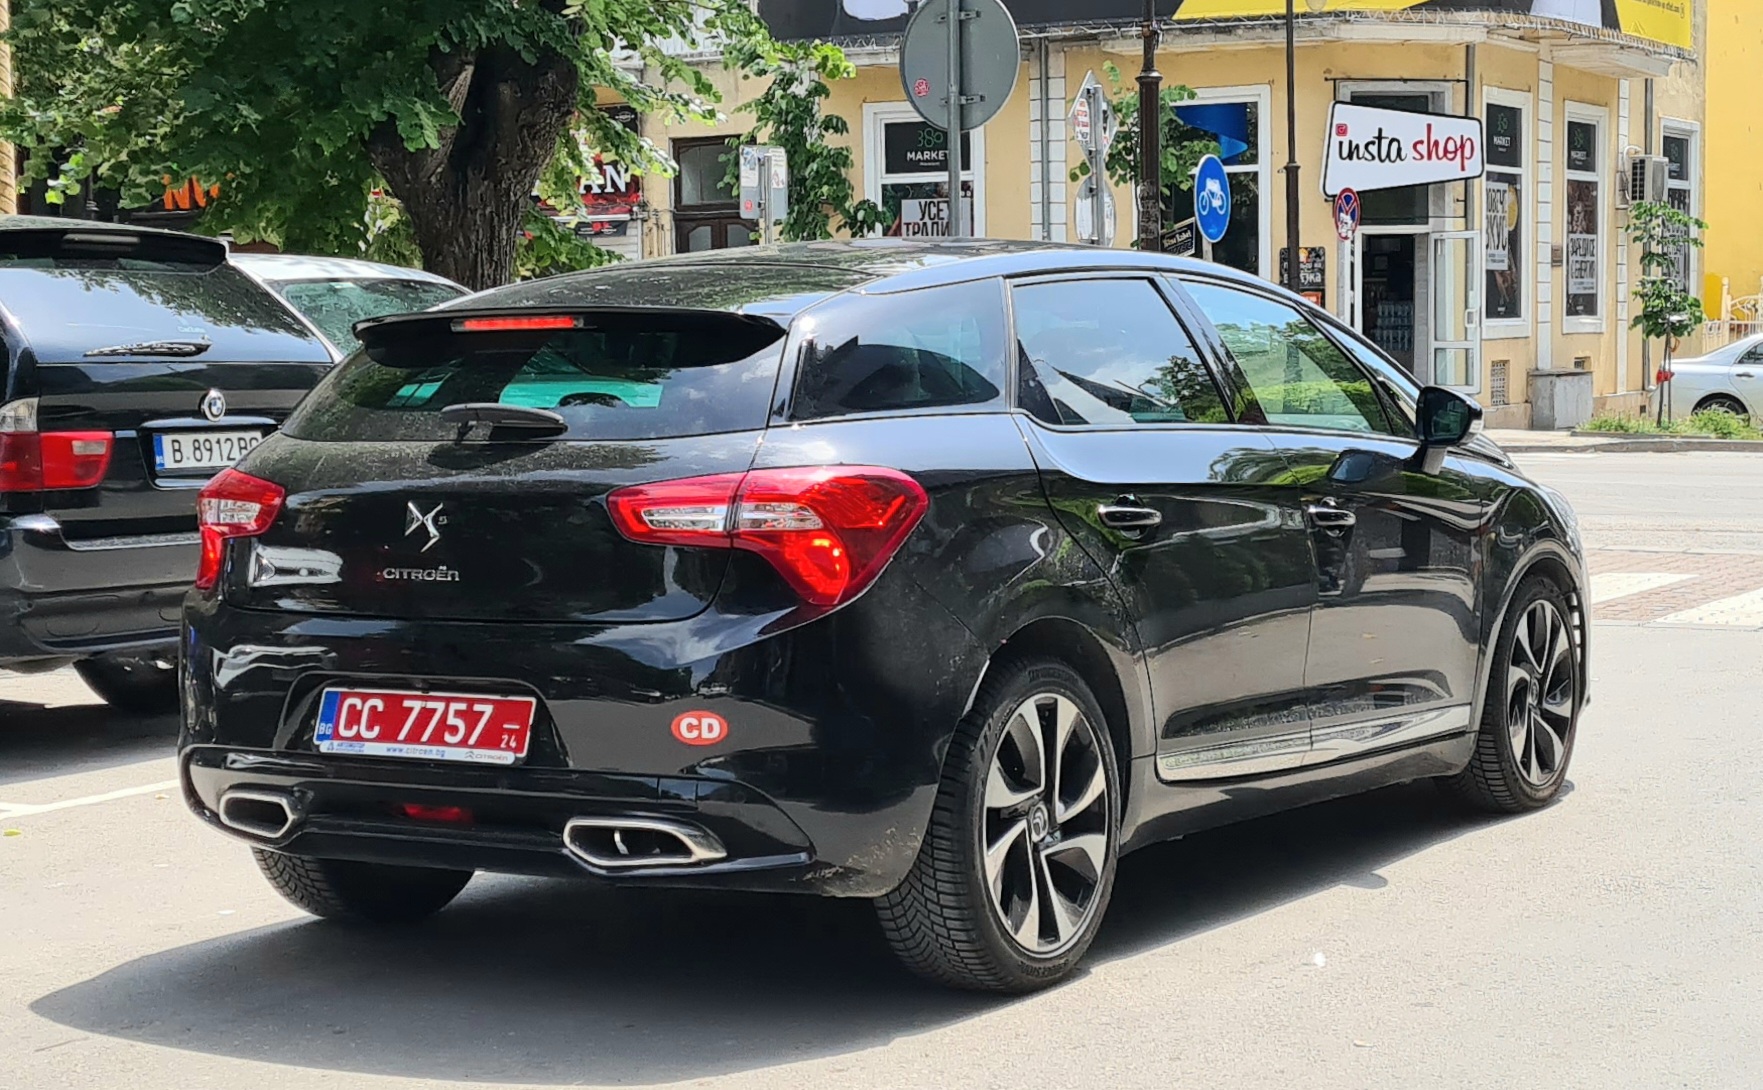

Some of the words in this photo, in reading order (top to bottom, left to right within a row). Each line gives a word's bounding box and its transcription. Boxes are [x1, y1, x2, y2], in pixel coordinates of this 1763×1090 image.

[1337, 126, 1407, 163] insta
[1411, 123, 1475, 172] shop
[318, 722, 332, 735] BG
[338, 697, 384, 739] CC
[397, 700, 494, 746] 7757
[680, 717, 720, 739] CD
[500, 734, 517, 749] 24
